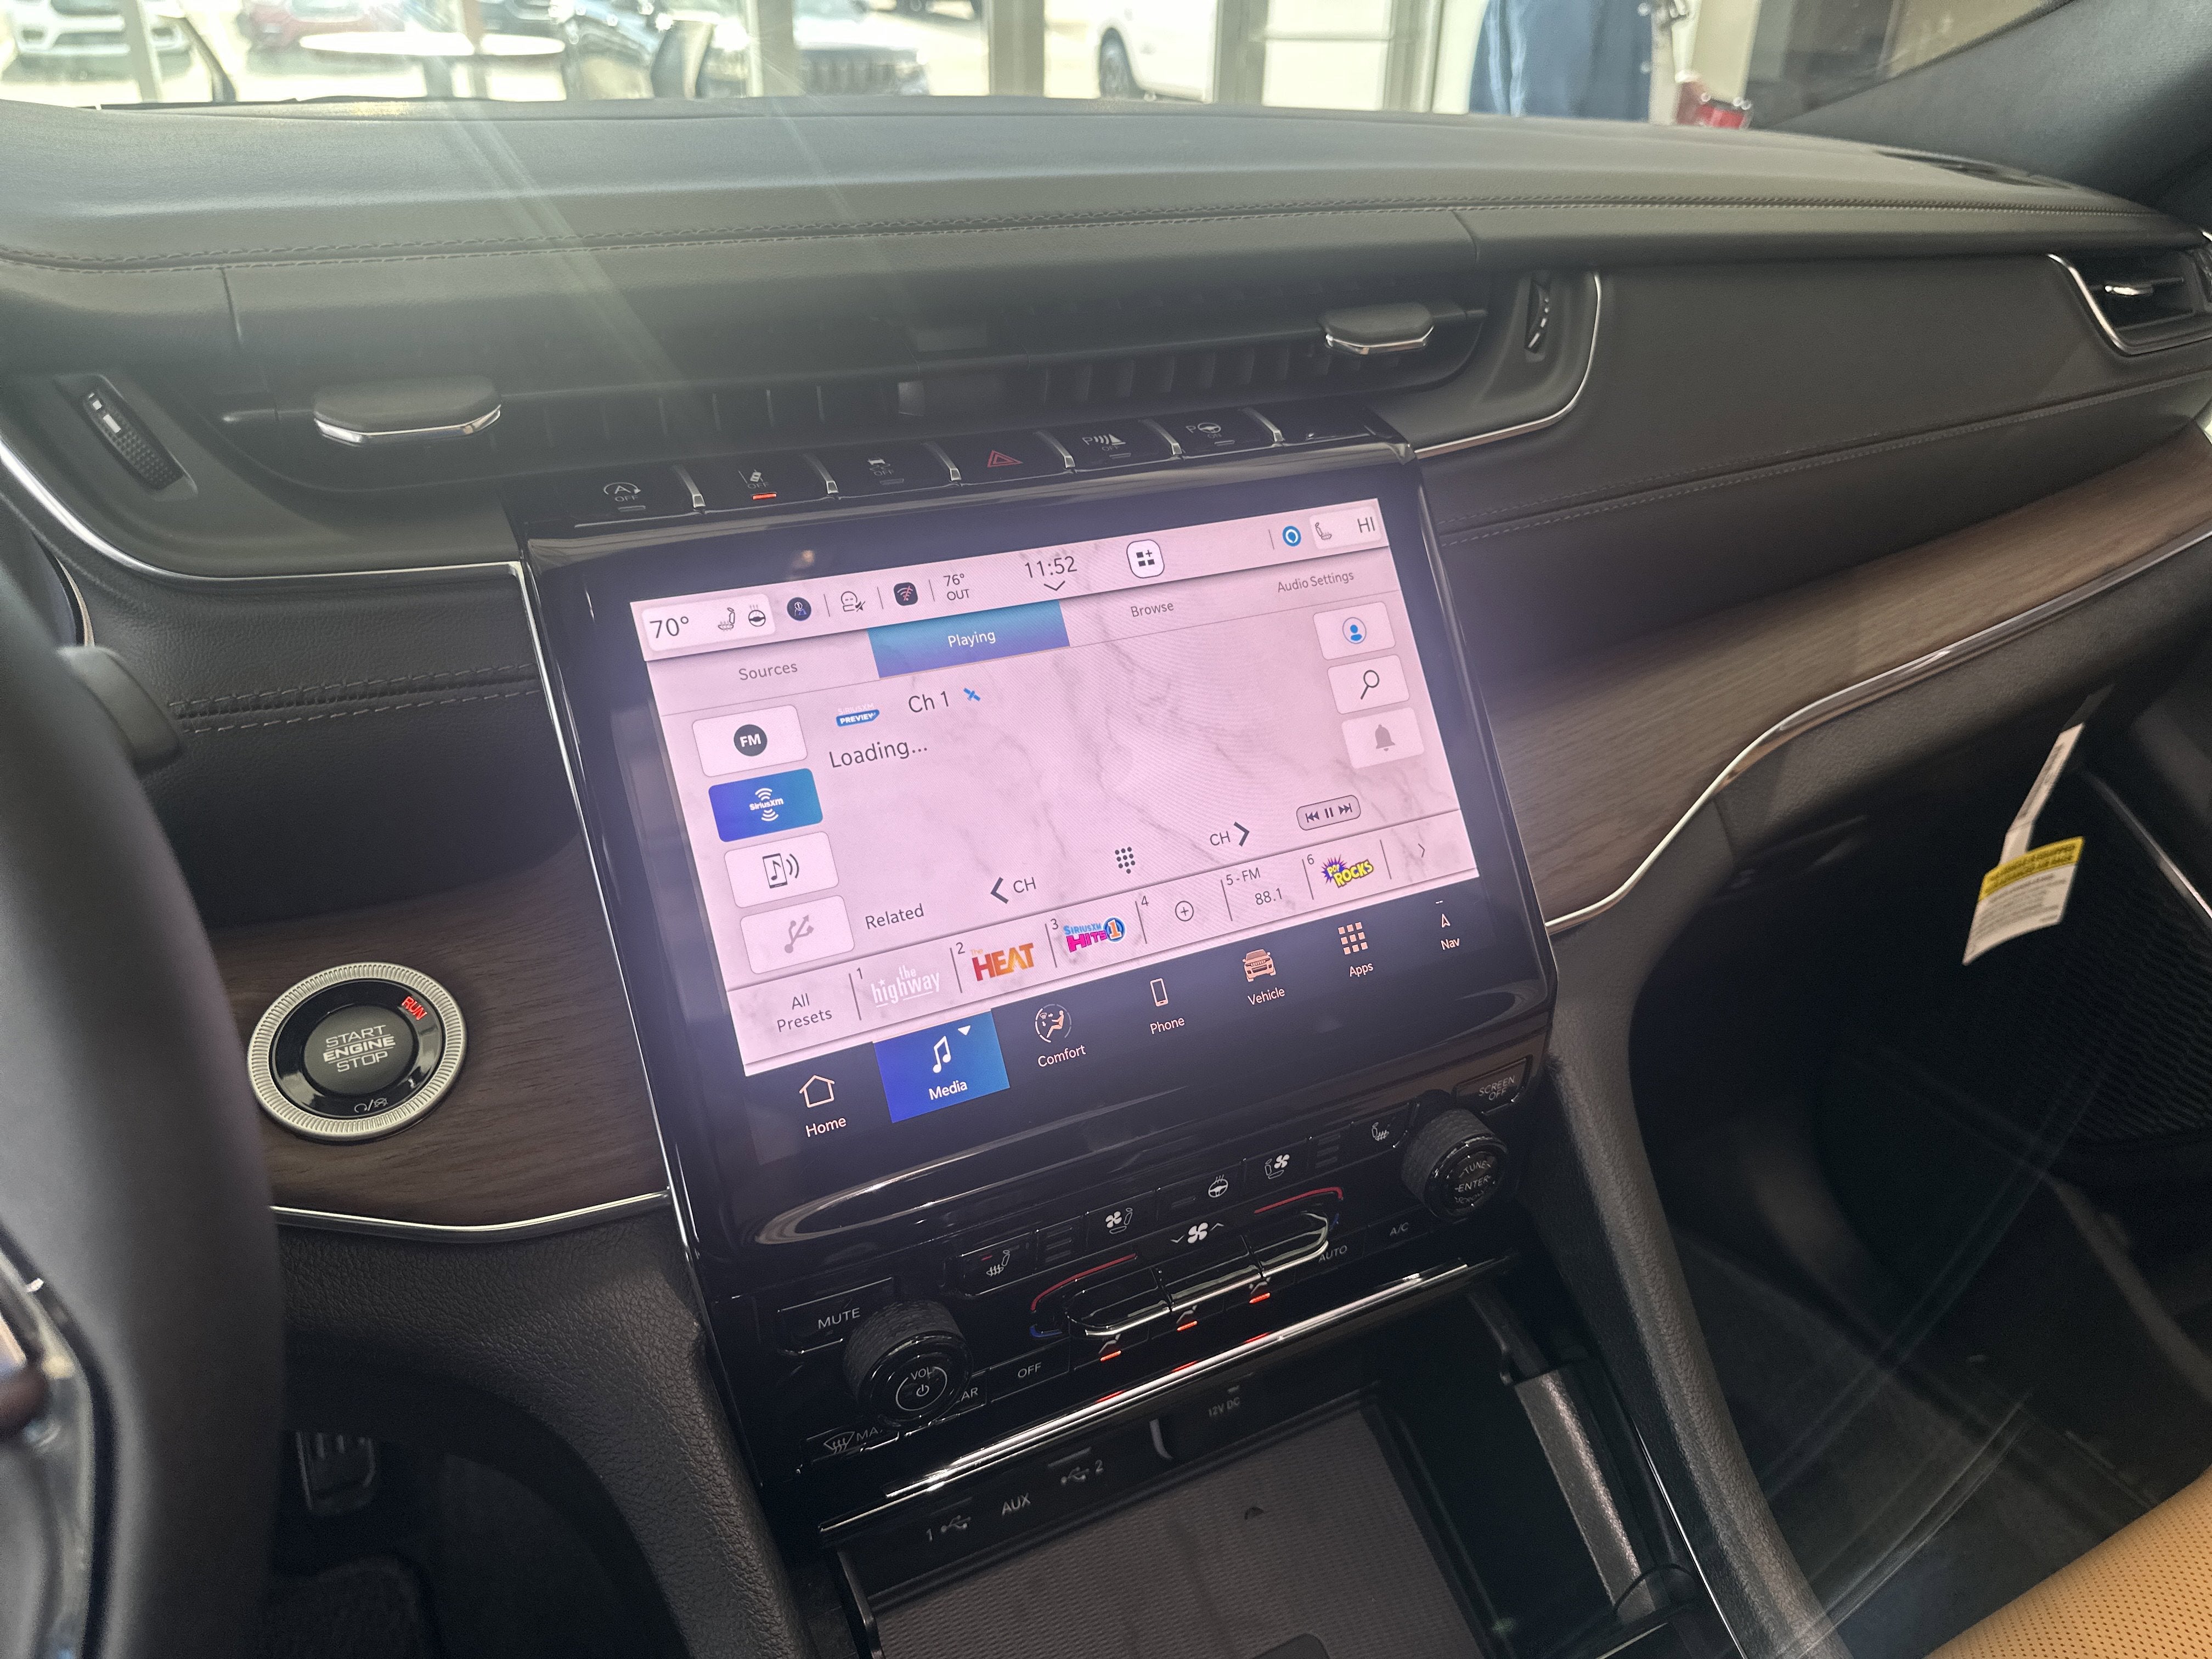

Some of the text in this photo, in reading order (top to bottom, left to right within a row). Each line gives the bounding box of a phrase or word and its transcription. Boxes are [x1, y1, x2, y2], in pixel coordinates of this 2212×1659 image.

[1358, 516, 1376, 534] HI
[1025, 556, 1077, 579] 11:52
[943, 573, 966, 588] 76°
[1277, 571, 1355, 593] Audio Settings
[947, 589, 970, 602] OUT
[1130, 600, 1175, 618] Browse
[650, 615, 689, 639] 70°
[947, 629, 996, 650] Playing
[738, 661, 798, 681] Sources
[908, 691, 950, 714] Ch 1
[839, 712, 877, 725] PREVIEW
[740, 733, 762, 747] FM
[829, 737, 928, 769] Loading...
[1210, 830, 1231, 845] CH
[1307, 854, 1314, 865] 6
[1226, 874, 1233, 885] 5
[1242, 867, 1261, 882] FM
[1333, 859, 1374, 888] ROCKS
[1013, 877, 1037, 894] CH
[1141, 895, 1149, 907] 4
[1255, 888, 1282, 905] 88.1
[865, 903, 924, 929] Related
[1050, 918, 1059, 930] 3
[957, 942, 966, 955] 2
[1066, 929, 1107, 953] HITS
[1440, 938, 1460, 950] Nav
[970, 948, 983, 957] The
[971, 942, 1035, 981] HEAT
[856, 967, 863, 979] 1
[899, 964, 916, 980] the
[1348, 961, 1374, 977] Apps
[871, 972, 940, 1005] highway
[1248, 986, 1285, 1006] Vehicle
[401, 996, 427, 1020] RUN
[791, 992, 810, 1010] All
[777, 1008, 833, 1032] Presets
[1149, 1015, 1186, 1035] Phone
[325, 1024, 387, 1048] START
[323, 1036, 396, 1062] ENGINE
[1037, 1044, 1087, 1068] Comfort
[337, 1051, 388, 1073] STOP
[928, 1078, 968, 1101] Media
[1479, 1075, 1515, 1097] SCREEN
[1488, 1087, 1507, 1101] OFF
[805, 1115, 847, 1138] Home
[1463, 1160, 1487, 1174] TUNE
[1458, 1176, 1489, 1192] ENTER
[1390, 1222, 1409, 1236] A/C
[1318, 1245, 1347, 1262] AUTO
[817, 1307, 861, 1329] MUTE
[910, 1367, 932, 1380] VOL
[1017, 1362, 1042, 1378] OFF
[960, 1387, 978, 1402] AR
[857, 1426, 883, 1442] MA
[1094, 1459, 1104, 1474] 2
[1001, 1492, 1031, 1516] AUX
[926, 1528, 933, 1542] 1
